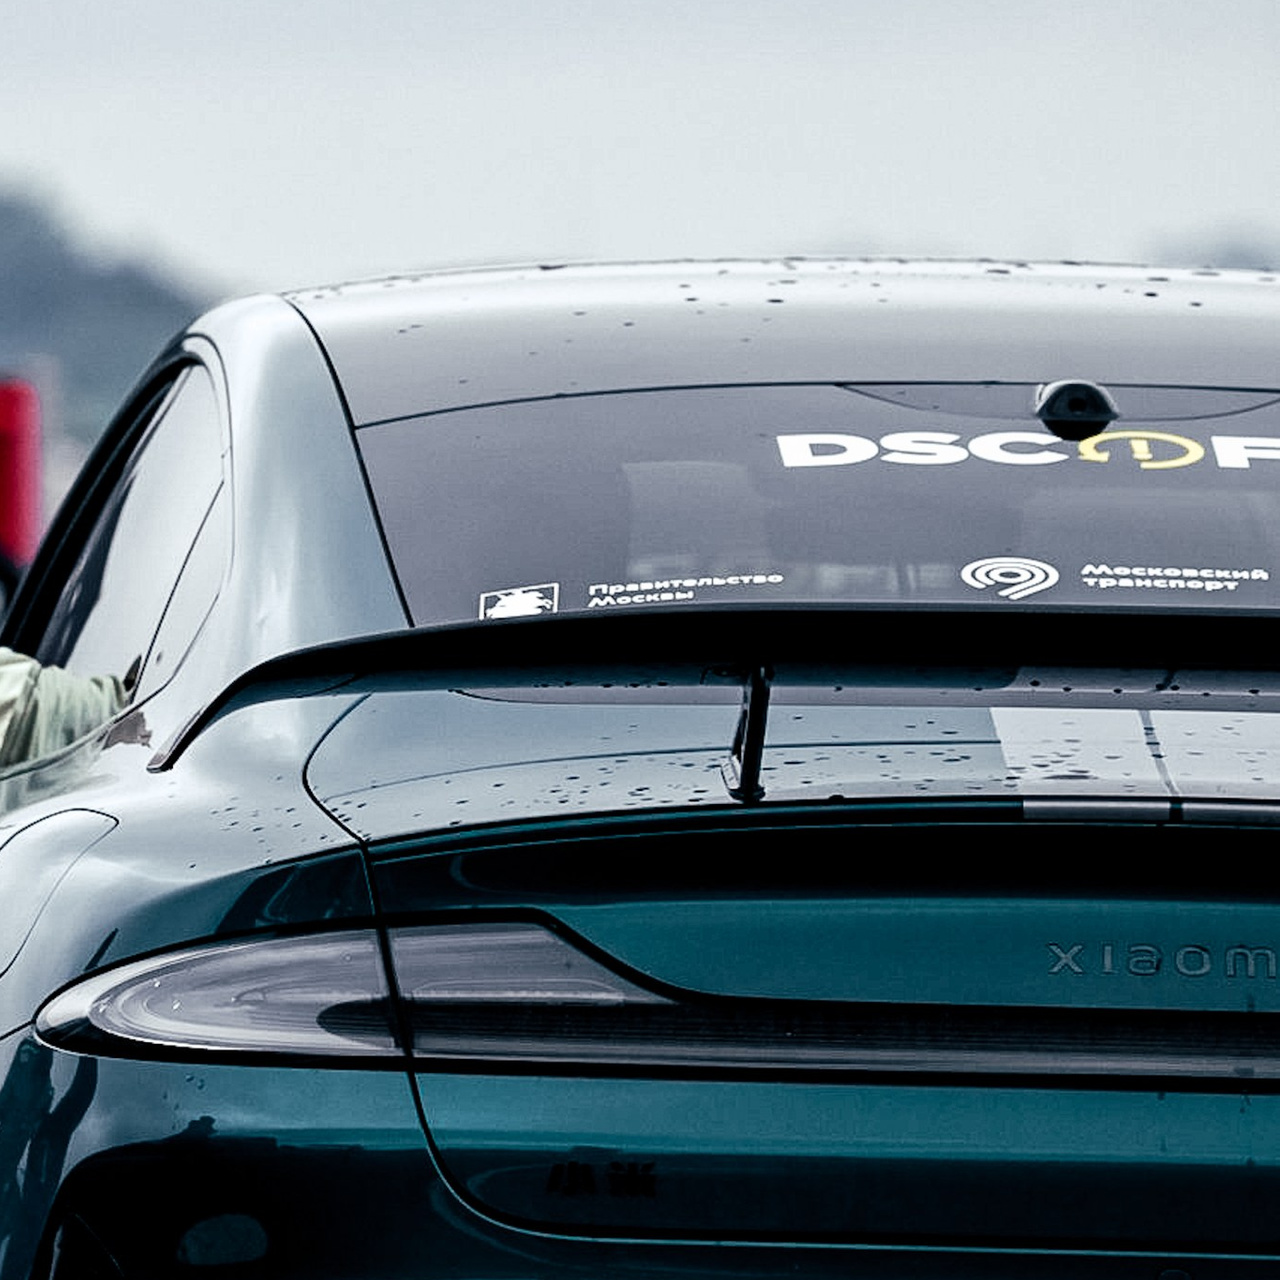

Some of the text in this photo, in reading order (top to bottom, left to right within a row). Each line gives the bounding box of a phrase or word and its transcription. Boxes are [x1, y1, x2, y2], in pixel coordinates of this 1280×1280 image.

[1081, 564, 1269, 580] Московский
[588, 574, 784, 596] Правительство
[1082, 577, 1239, 591] транспорт
[587, 590, 694, 608] Москвы
